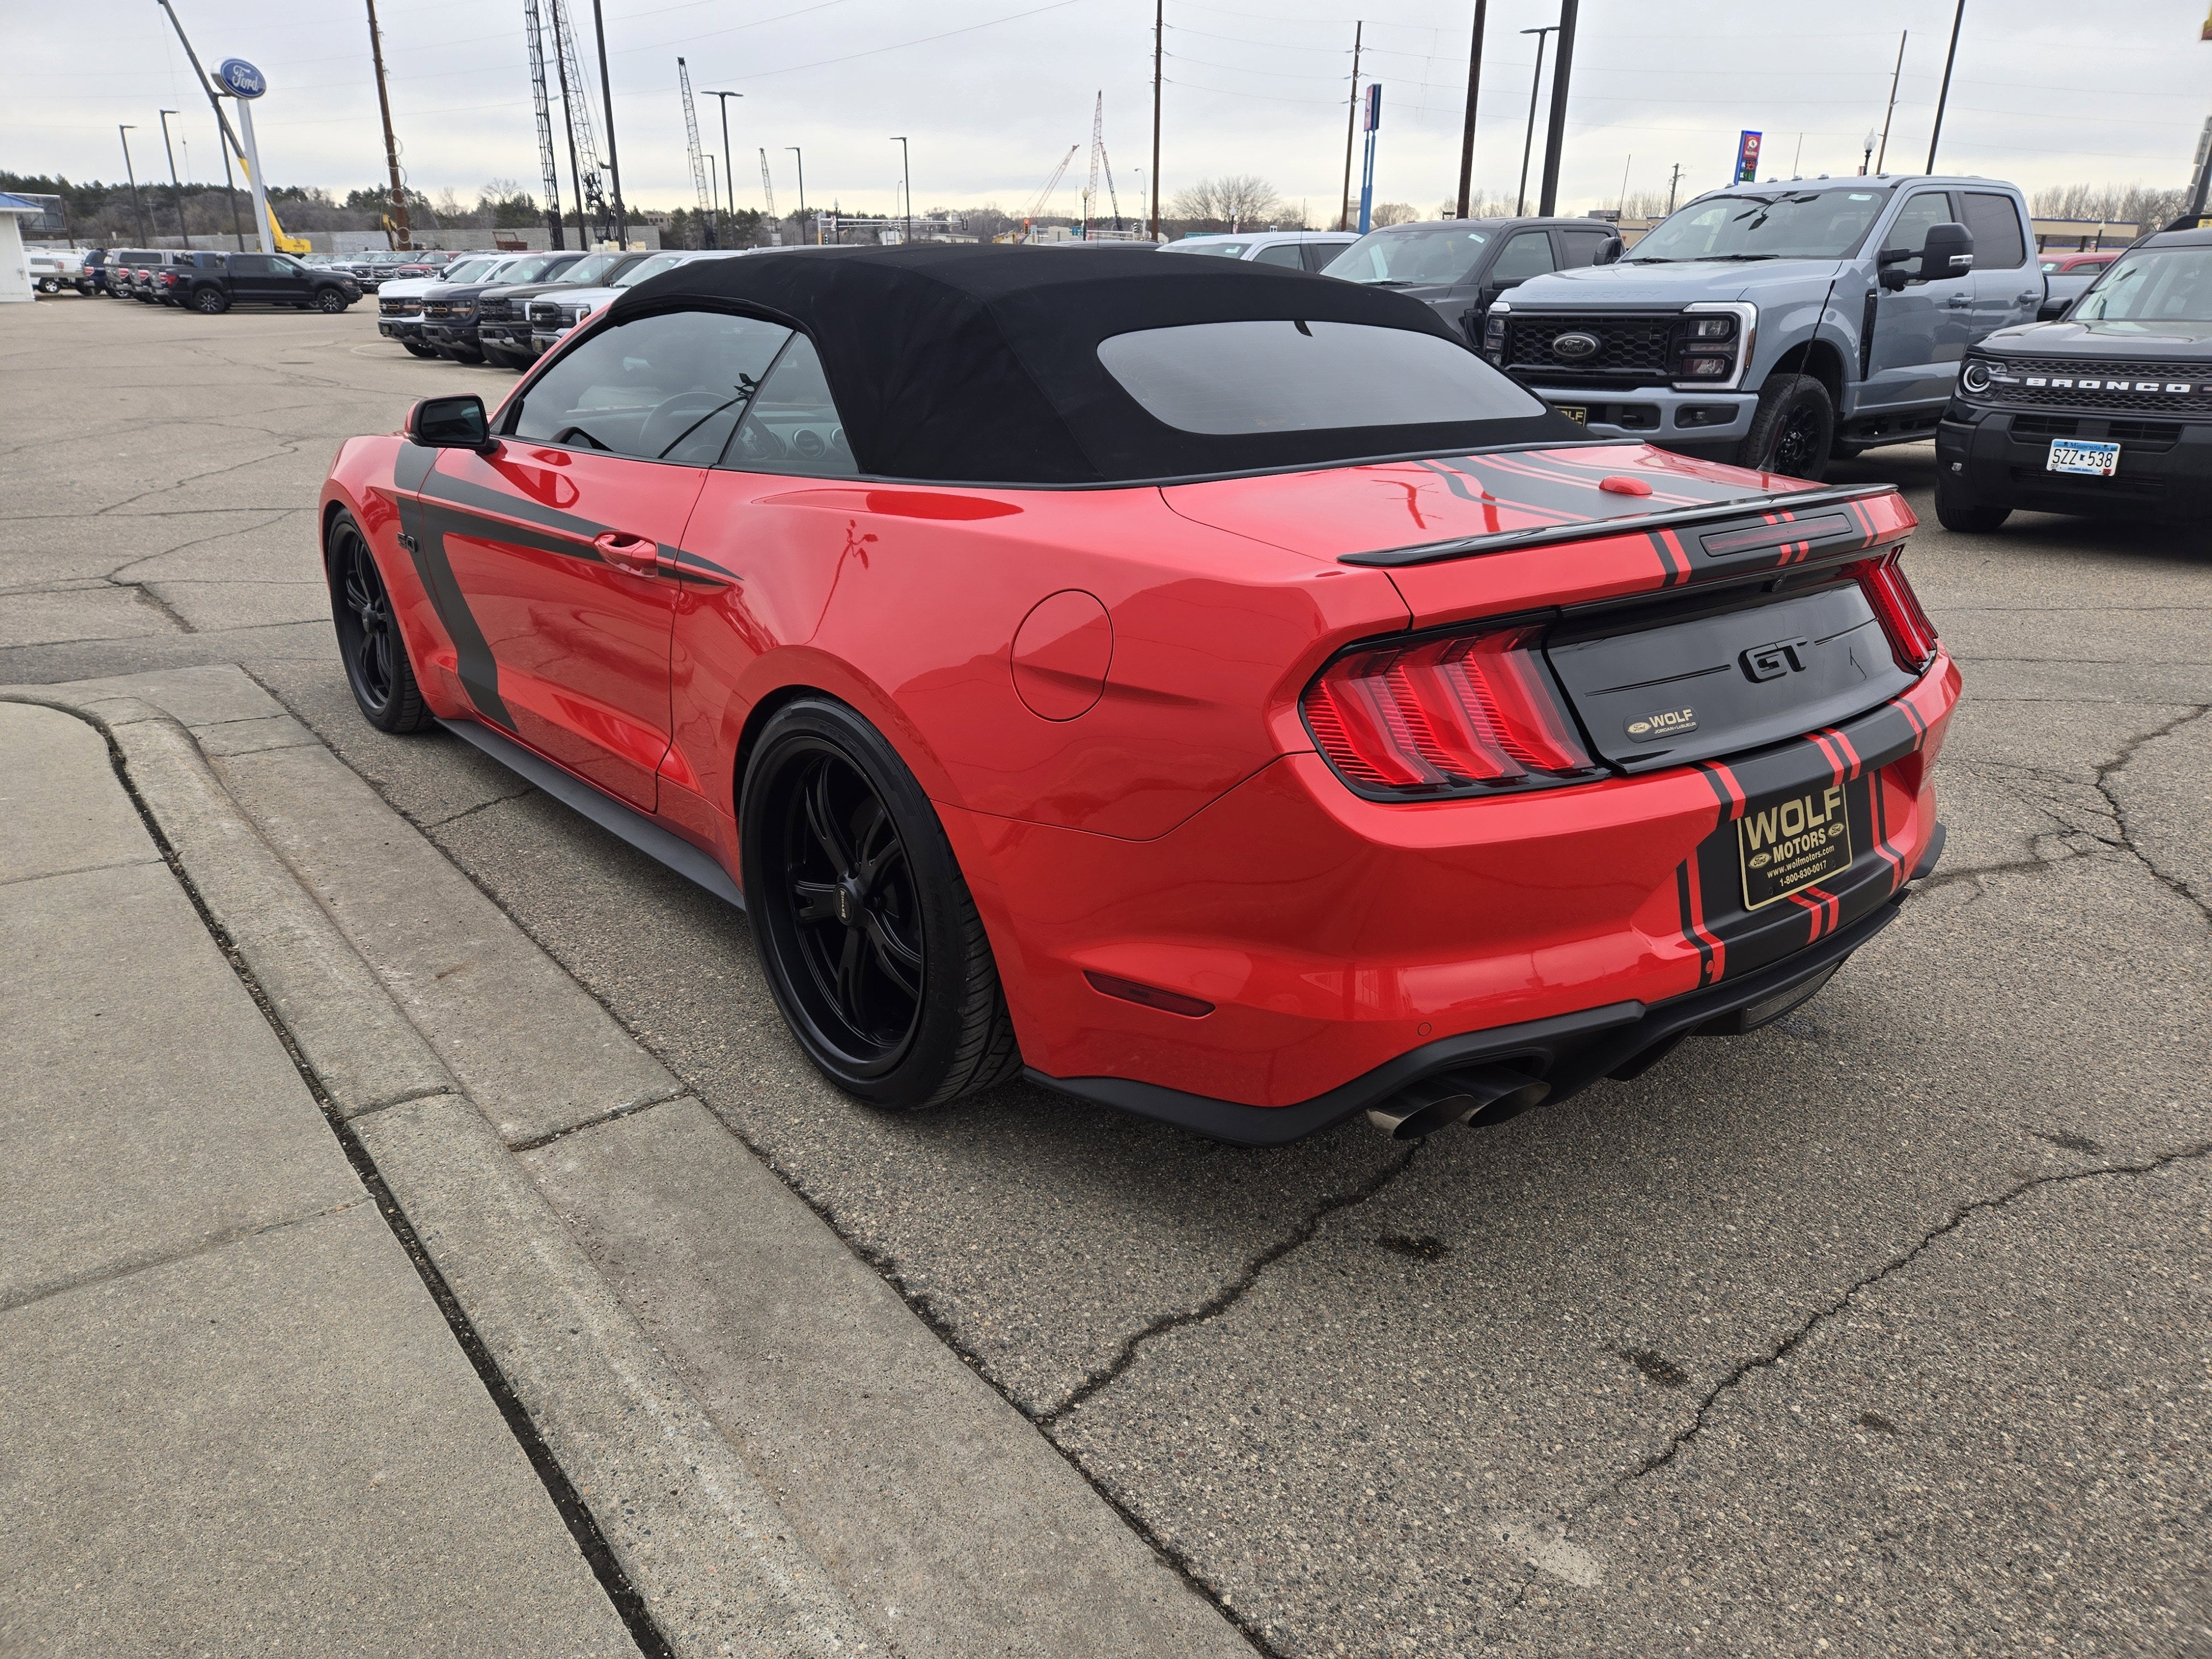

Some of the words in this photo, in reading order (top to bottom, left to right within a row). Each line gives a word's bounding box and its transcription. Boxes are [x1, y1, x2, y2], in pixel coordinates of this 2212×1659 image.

[232, 65, 259, 91] Ford
[1562, 340, 1585, 352] Ford
[2026, 378, 2190, 393] BRONCO
[1738, 636, 1808, 684] GT
[1649, 709, 1693, 728] WOLF
[1744, 786, 1840, 851] WOLF
[1754, 855, 1766, 866] Ford
[1772, 828, 1826, 863] MOTORS
[1831, 825, 1841, 834] Ford
[1767, 845, 1834, 878] www.wolfmotors.com
[1780, 860, 1827, 887] 1-800-830-0017
